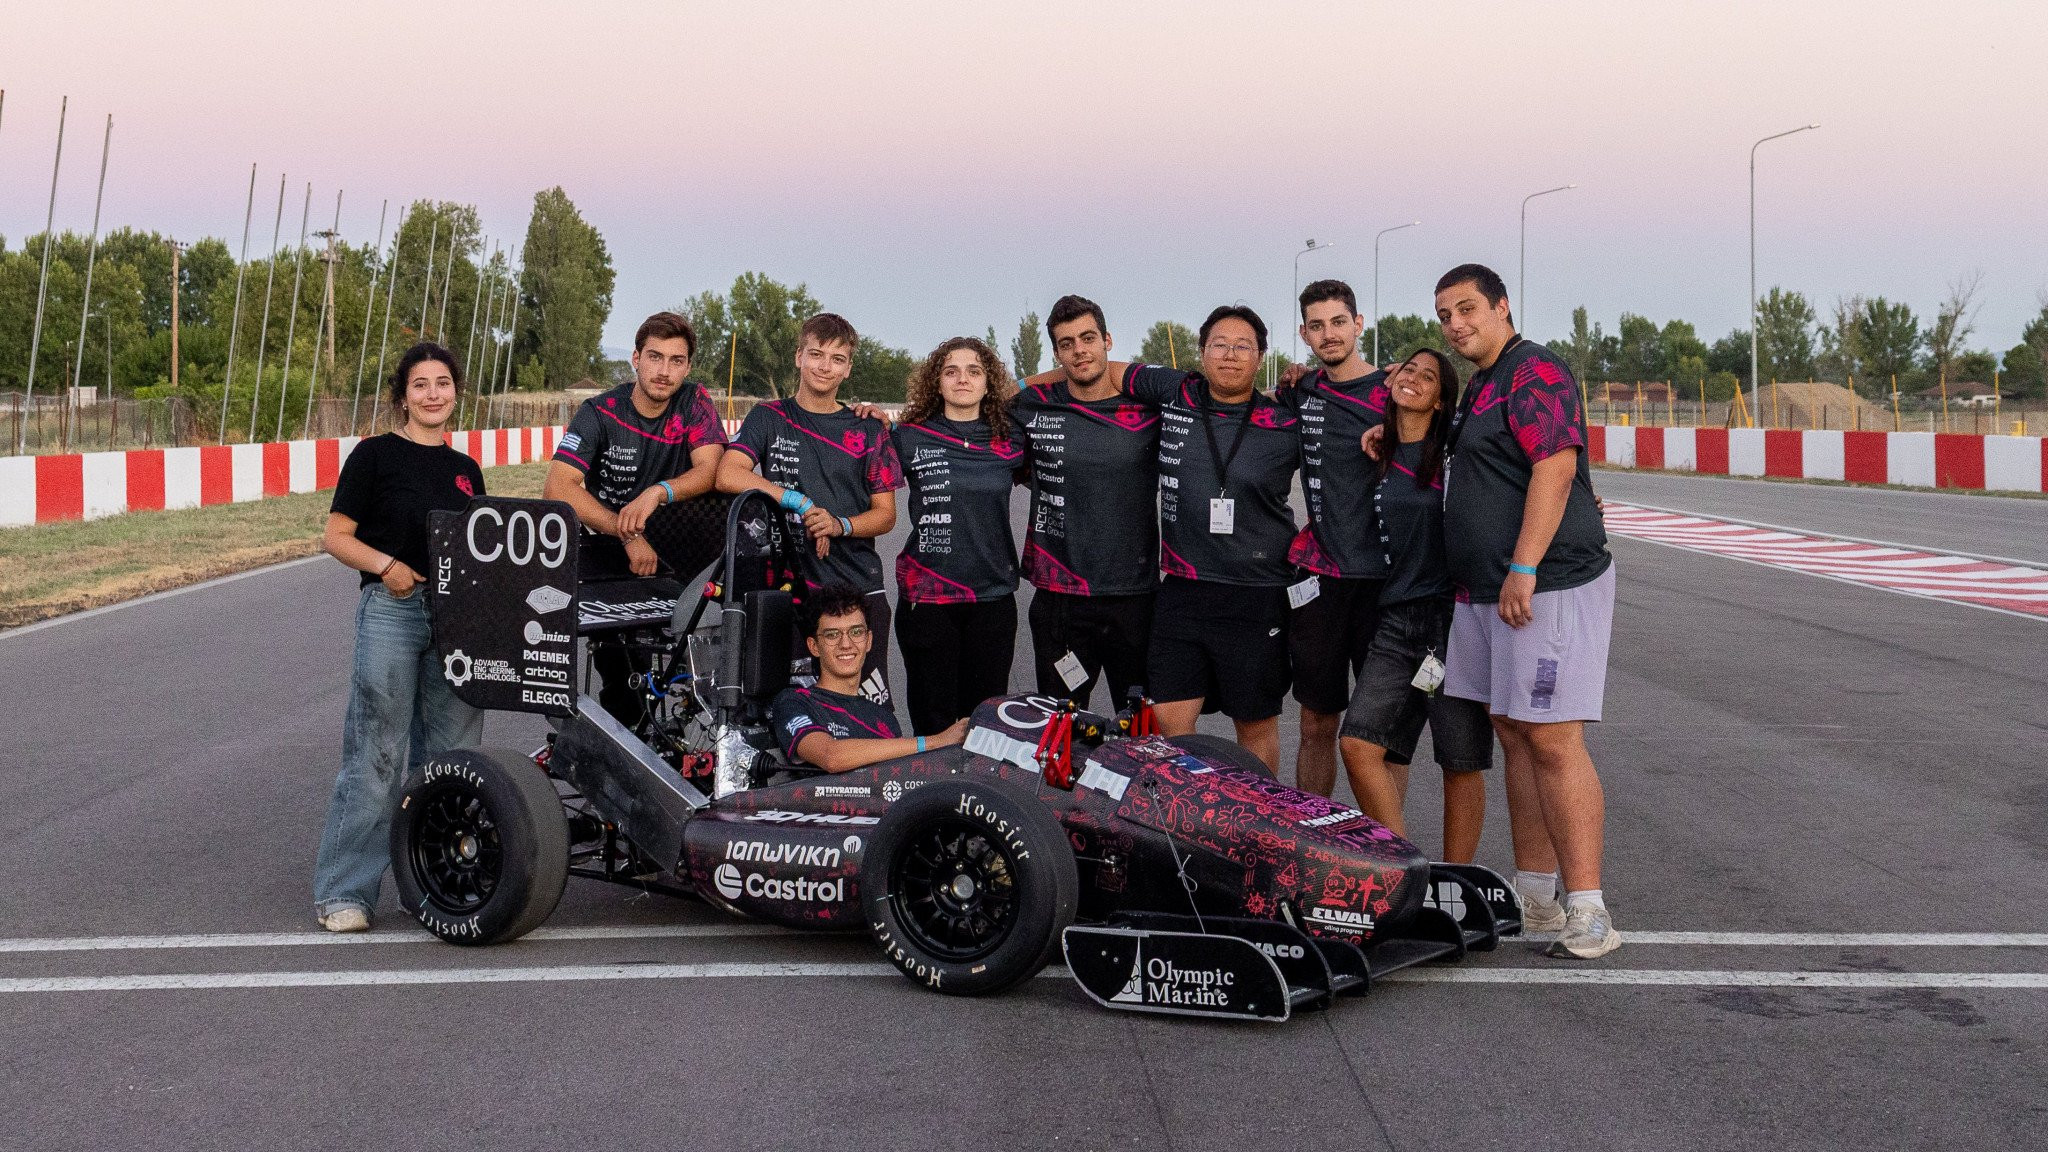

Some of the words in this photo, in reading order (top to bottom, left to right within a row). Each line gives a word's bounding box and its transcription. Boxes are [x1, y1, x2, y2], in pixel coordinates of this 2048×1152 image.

[1038, 415, 1065, 425] Olympic
[1164, 412, 1194, 423] MEVACO
[612, 445, 638, 455] Olympic
[920, 448, 947, 456] Olympic
[924, 469, 950, 477] ALTAIR
[1041, 473, 1064, 483] Castrol
[467, 507, 568, 569] C09
[929, 527, 952, 536] Public
[926, 544, 952, 554] Group
[473, 659, 509, 668] ADVANCED
[473, 665, 516, 675] ENGNEERING
[474, 672, 521, 683] TECHNOLOGIES
[525, 666, 568, 682] arthon
[522, 690, 570, 706] ELEGOO
[424, 760, 485, 788] Hoosier
[825, 786, 871, 795] THYRATRON
[1305, 809, 1363, 828] MEVACO
[955, 793, 1030, 860] Hoosier
[746, 873, 844, 902] Castrol
[1312, 907, 1375, 925] ELVAL
[419, 910, 482, 938] Hoosier
[873, 921, 947, 988] Hoosier
[1147, 958, 1234, 991] Olympic
[1147, 982, 1229, 1006] Marine
